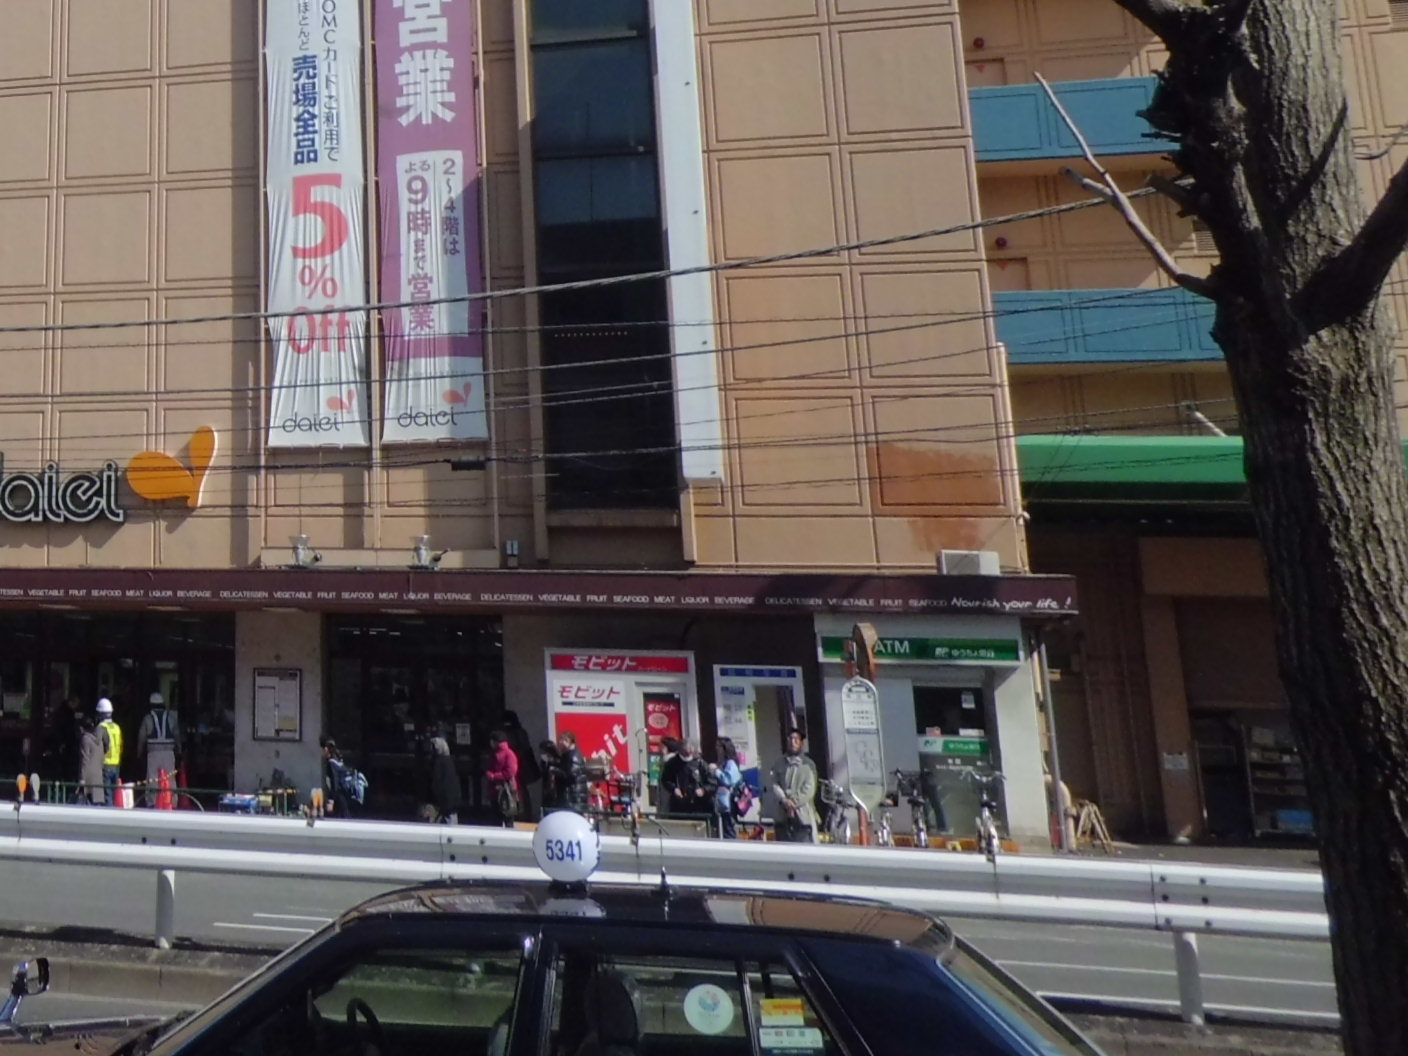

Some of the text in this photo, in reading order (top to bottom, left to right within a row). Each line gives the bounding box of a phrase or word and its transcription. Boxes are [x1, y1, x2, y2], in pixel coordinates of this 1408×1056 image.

[282, 411, 340, 433] daiei
[397, 406, 457, 428] daiei
[149, 589, 173, 597] LIQUOR
[177, 590, 212, 598] BEVERAGE
[273, 591, 313, 599] VEGETABLE
[480, 593, 533, 601] DELICATESSEN
[538, 594, 581, 602] VEGETABLE
[613, 595, 649, 603] SEAFOOD
[654, 595, 675, 603] MEAT
[681, 596, 709, 604] LIQUOR
[714, 596, 754, 604] BEVERAGE
[765, 597, 822, 605] DELICATESSEN
[827, 598, 875, 606] VEGETABLE
[880, 599, 903, 607] FRUIT
[908, 599, 947, 607] SEAFOOD
[951, 597, 1000, 609] Nourish
[1003, 601, 1033, 611] your
[874, 641, 910, 654] ATM
[572, 655, 637, 671] モビット
[558, 685, 621, 700] モビット
[545, 839, 582, 861] 5341
